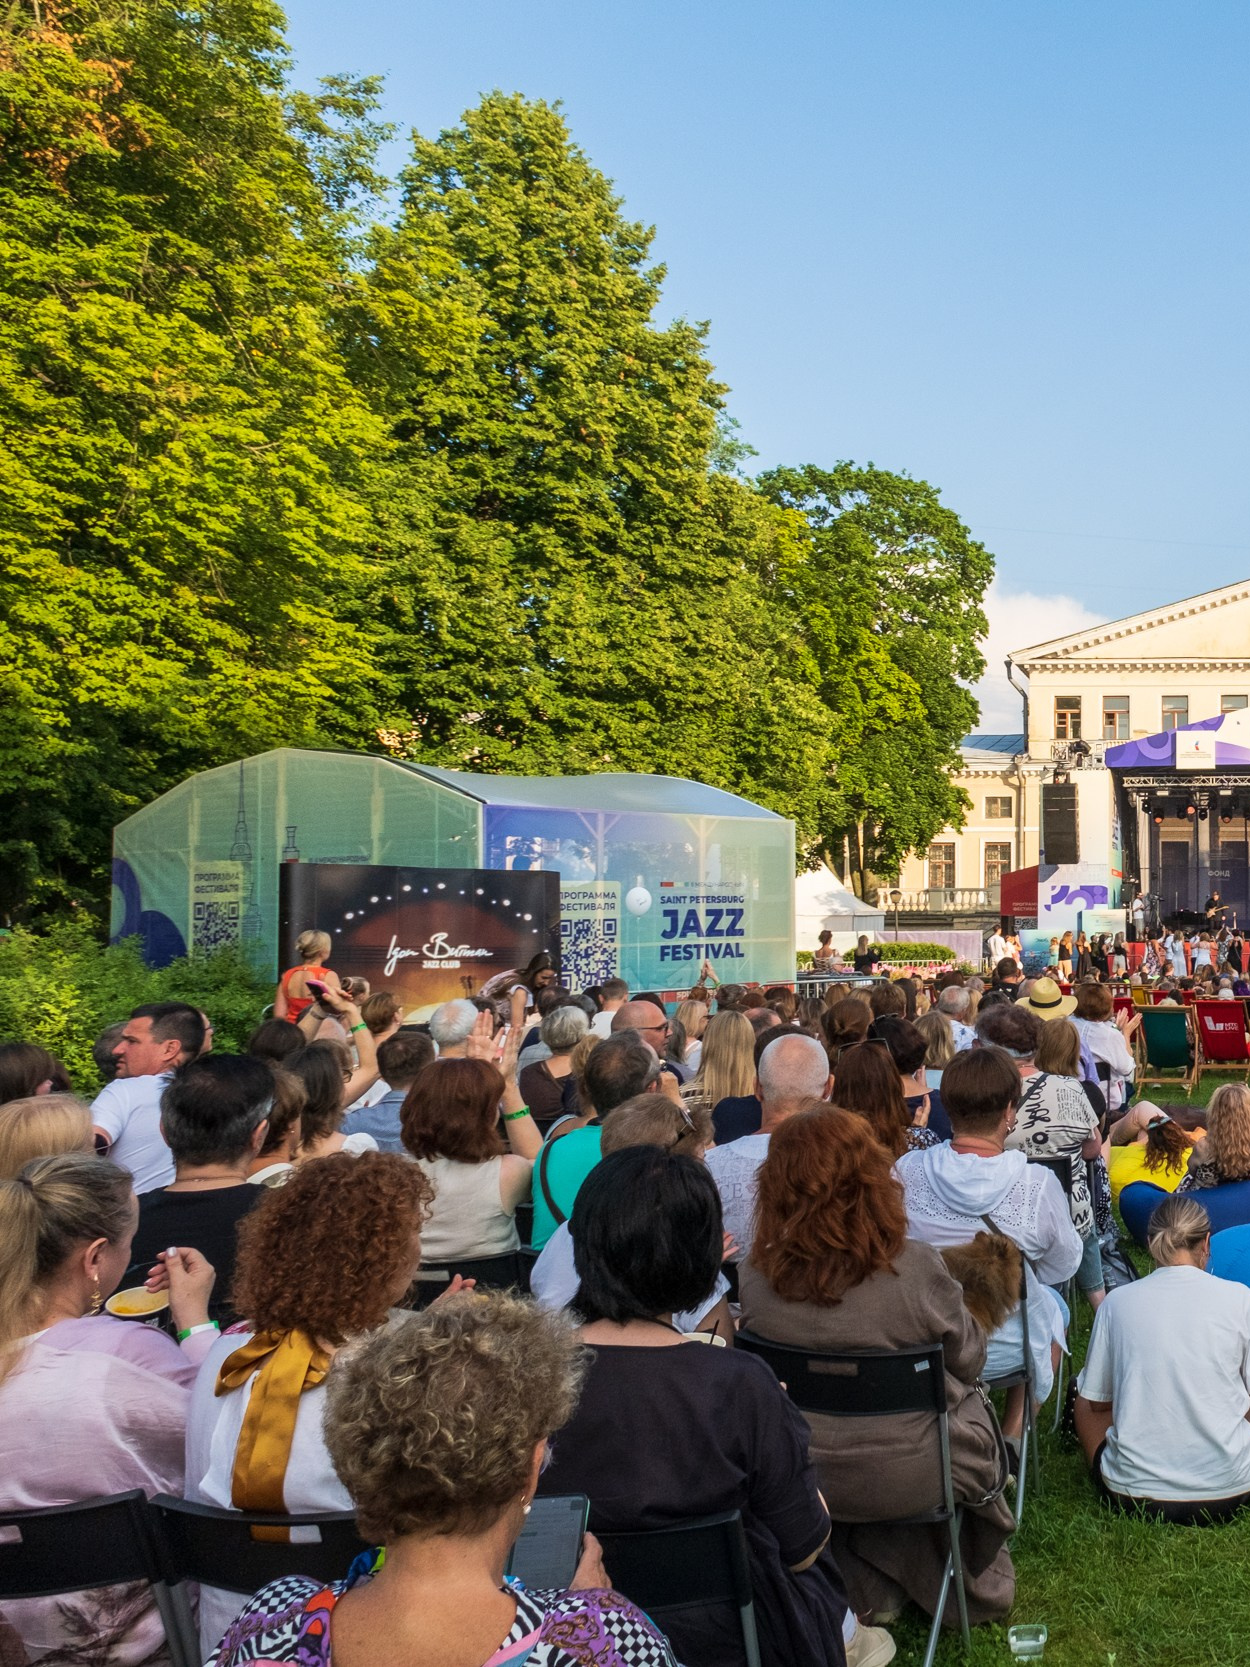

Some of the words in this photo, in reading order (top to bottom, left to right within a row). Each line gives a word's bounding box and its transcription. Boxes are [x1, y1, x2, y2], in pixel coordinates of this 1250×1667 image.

[193, 871, 240, 882] ПРОГРАММА
[194, 884, 240, 894] ФЕСТИВАЛЯ
[660, 895, 688, 904] SAINT
[689, 895, 745, 904] PETERSBURG
[660, 908, 745, 939] JAZZ
[660, 943, 745, 961] FESTIVAL
[422, 960, 440, 969] JAZZ
